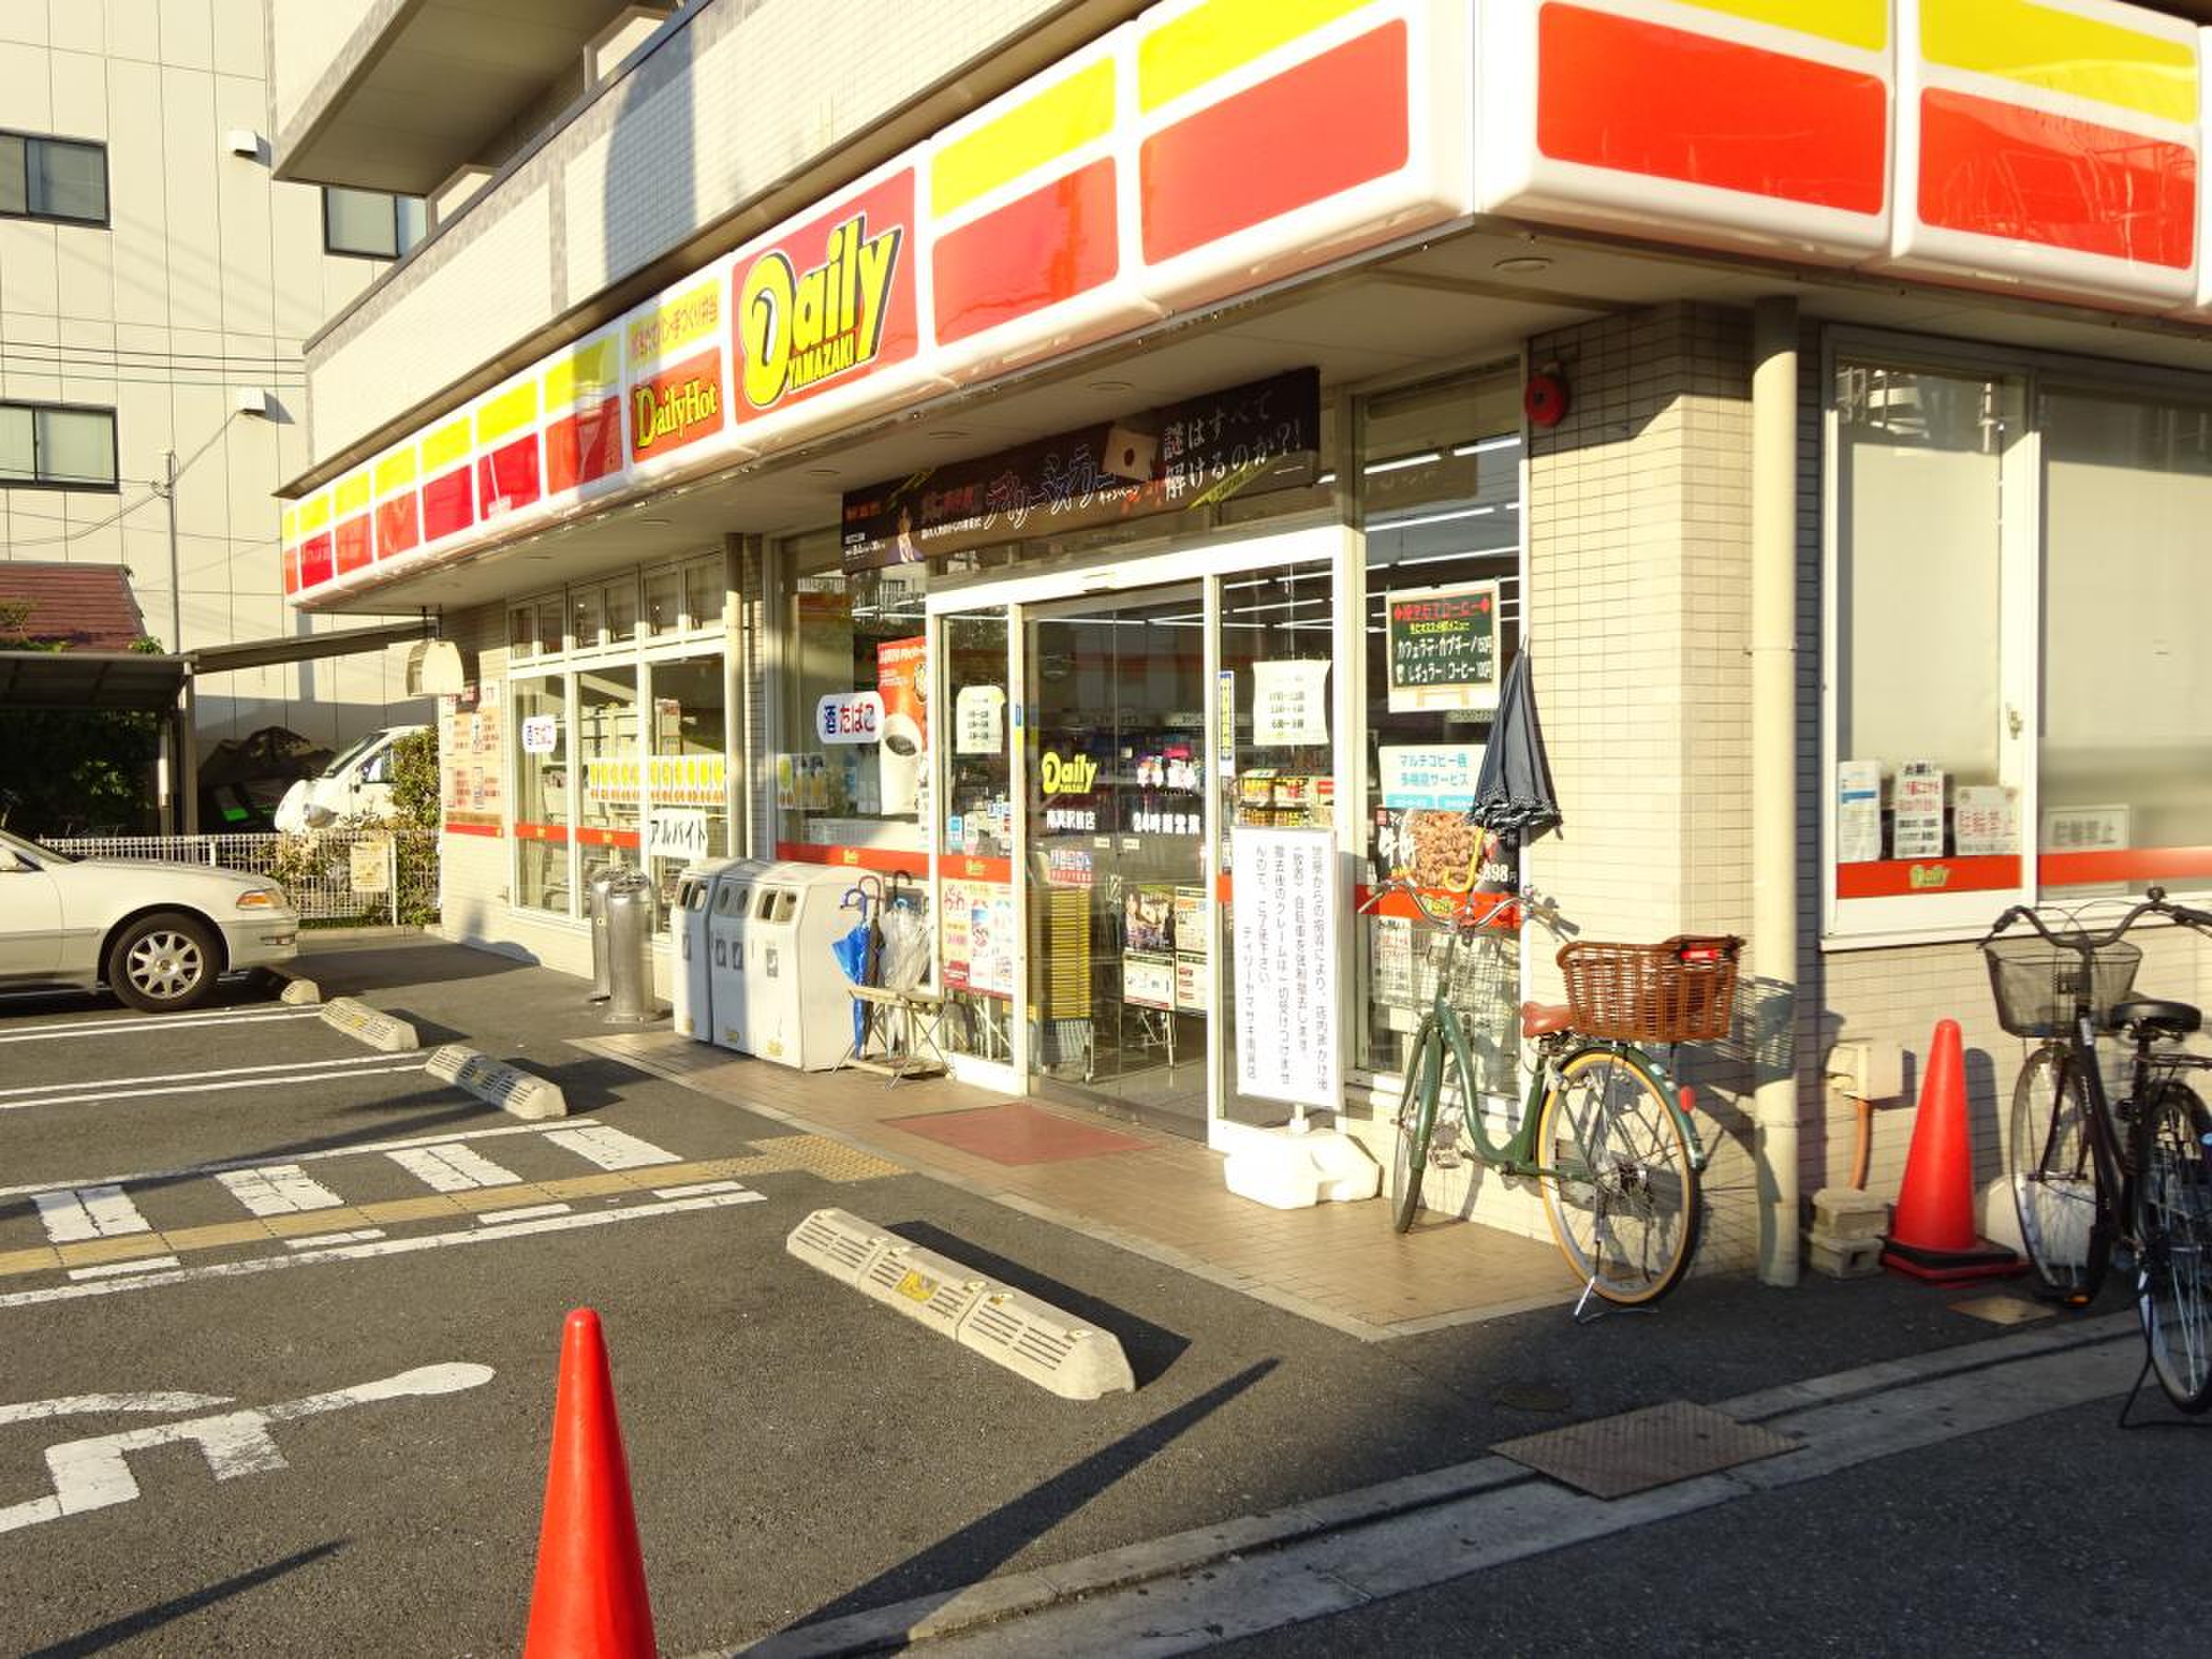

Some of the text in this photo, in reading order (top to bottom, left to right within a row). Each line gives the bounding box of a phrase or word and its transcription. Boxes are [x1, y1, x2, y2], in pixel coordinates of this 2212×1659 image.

[741, 216, 902, 406] Daily
[789, 333, 856, 389] YAMAZAKI
[840, 703, 876, 734] たばこ
[1041, 751, 1097, 794] Daily
[650, 819, 706, 851] アルバイト
